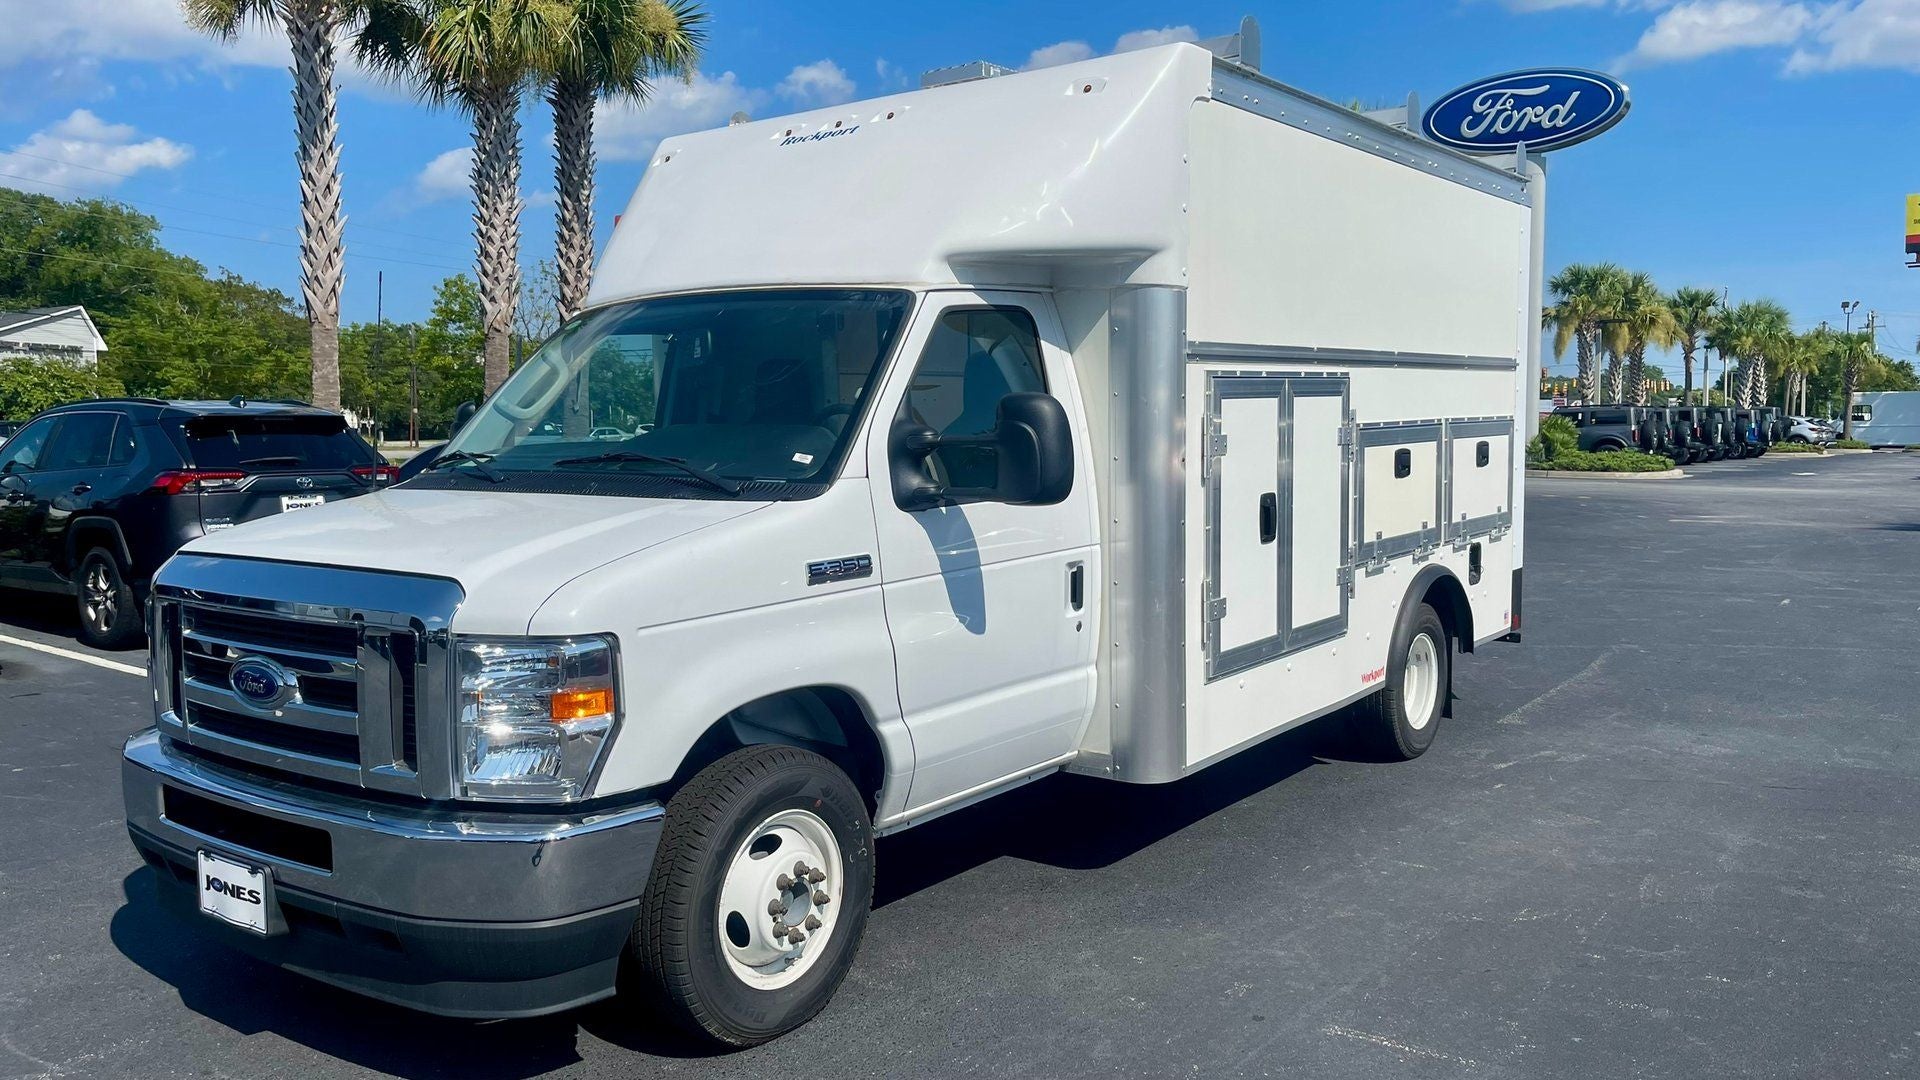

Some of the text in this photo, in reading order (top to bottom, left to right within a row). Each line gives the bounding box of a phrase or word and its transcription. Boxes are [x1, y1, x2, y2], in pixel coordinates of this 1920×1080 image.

[1460, 84, 1581, 139] Ford
[779, 125, 860, 146] Rockport
[239, 670, 267, 694] Ford
[204, 874, 262, 905] JONES
